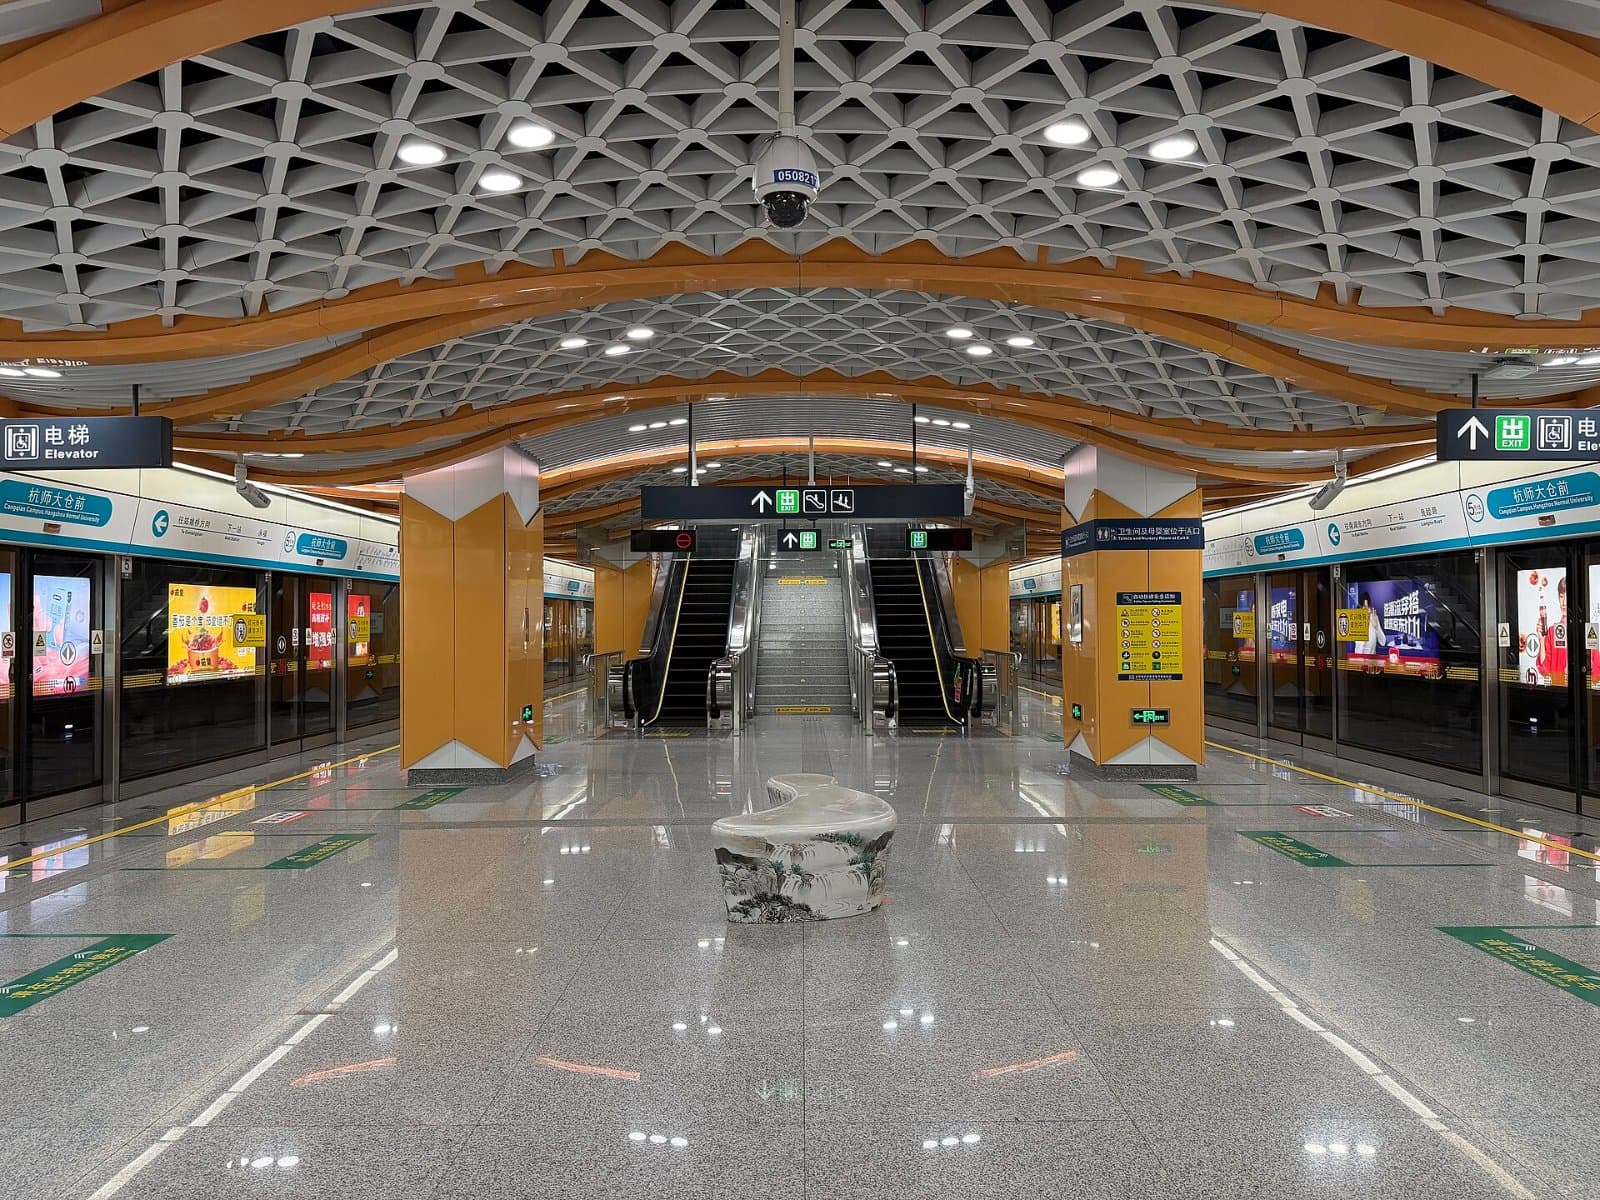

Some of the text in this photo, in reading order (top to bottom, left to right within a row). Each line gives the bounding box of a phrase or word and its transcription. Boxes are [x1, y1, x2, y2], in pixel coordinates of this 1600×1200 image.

[45, 424, 90, 446] 电梯
[1502, 440, 1523, 448] EXIT
[1578, 441, 1600, 451] Ele
[45, 449, 99, 459] Elevator
[1513, 480, 1568, 503] 杭师大仓前
[28, 487, 86, 511] 杭师大仓前
[124, 559, 130, 571] 5
